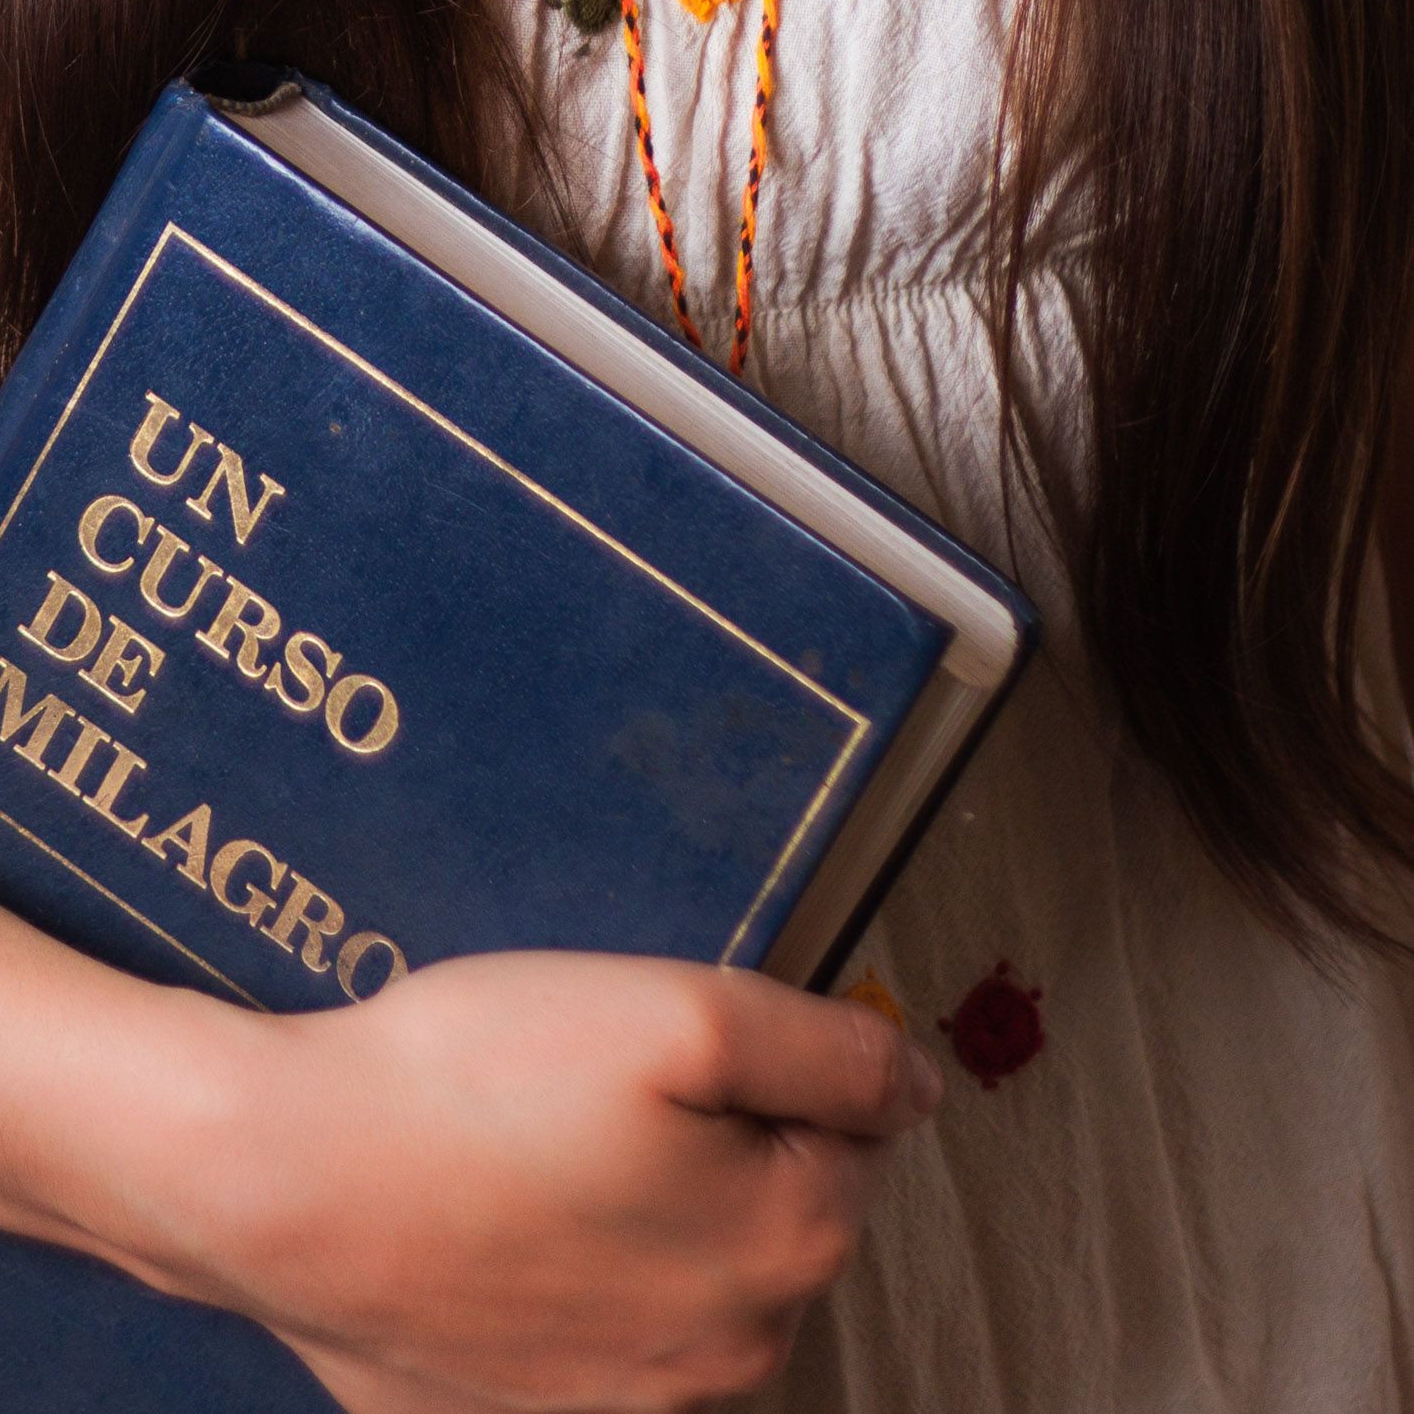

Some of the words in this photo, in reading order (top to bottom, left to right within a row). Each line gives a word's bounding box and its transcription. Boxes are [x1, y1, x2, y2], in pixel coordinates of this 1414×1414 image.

[129, 390, 285, 546] UN
[17, 570, 165, 714] DE
[78, 494, 399, 755] CURSO
